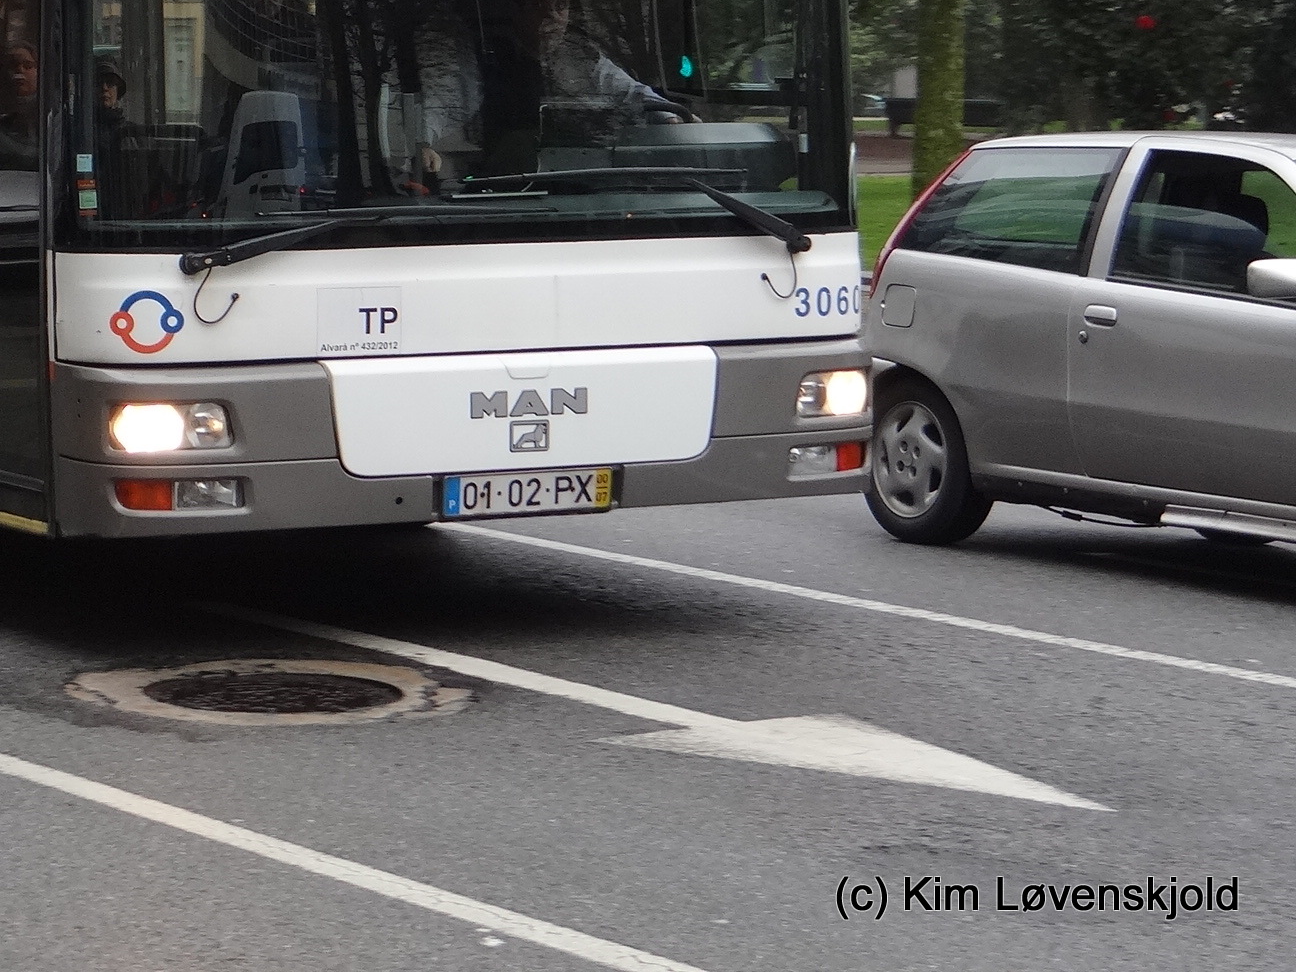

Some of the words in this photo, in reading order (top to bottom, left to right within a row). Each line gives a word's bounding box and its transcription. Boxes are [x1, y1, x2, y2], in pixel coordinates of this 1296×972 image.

[794, 284, 860, 318] 3060
[358, 307, 399, 335] TP
[360, 341, 399, 351] 432/2012
[470, 387, 588, 419] MAN
